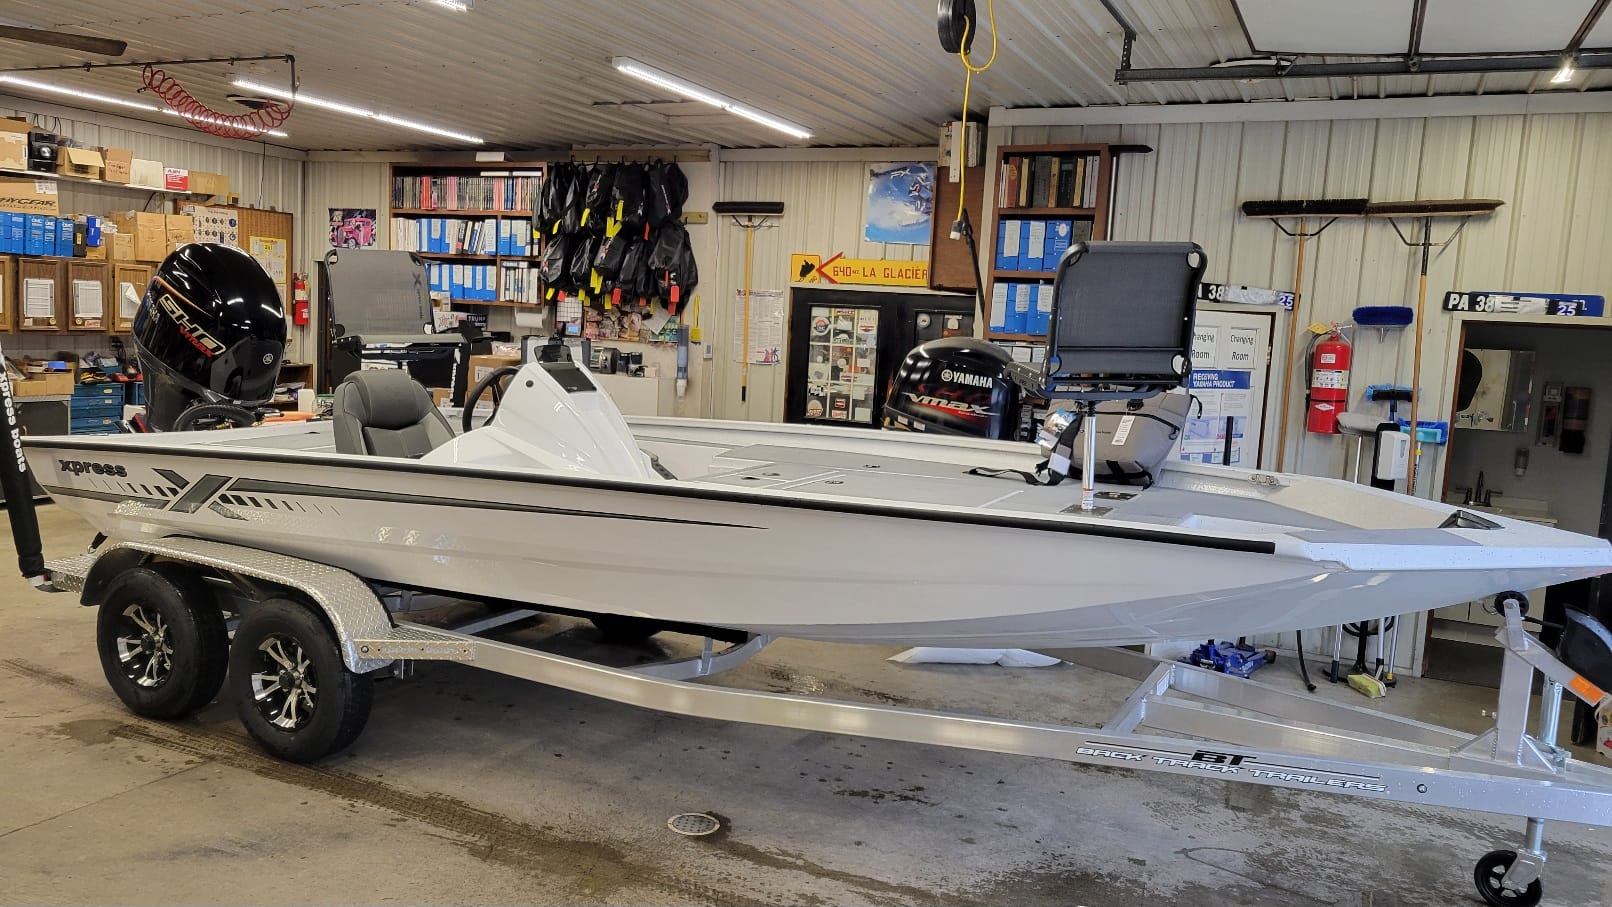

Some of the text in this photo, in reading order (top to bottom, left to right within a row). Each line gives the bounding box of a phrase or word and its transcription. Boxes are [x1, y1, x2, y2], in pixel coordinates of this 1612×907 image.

[833, 266, 851, 277] 640
[862, 267, 876, 277] LA
[1208, 285, 1225, 300] 38
[1279, 295, 1294, 306] 25
[1448, 293, 1495, 312] PA 38
[1556, 304, 1576, 316] 25
[159, 294, 226, 356] SHO
[1230, 334, 1254, 346] Changing
[1191, 350, 1210, 359] Room
[1231, 352, 1249, 360] Room
[953, 371, 993, 388] YAMAHA
[11, 427, 27, 473] boats
[59, 459, 128, 477] xpress
[1076, 746, 1388, 793] BACK TRACK TRAILERS
